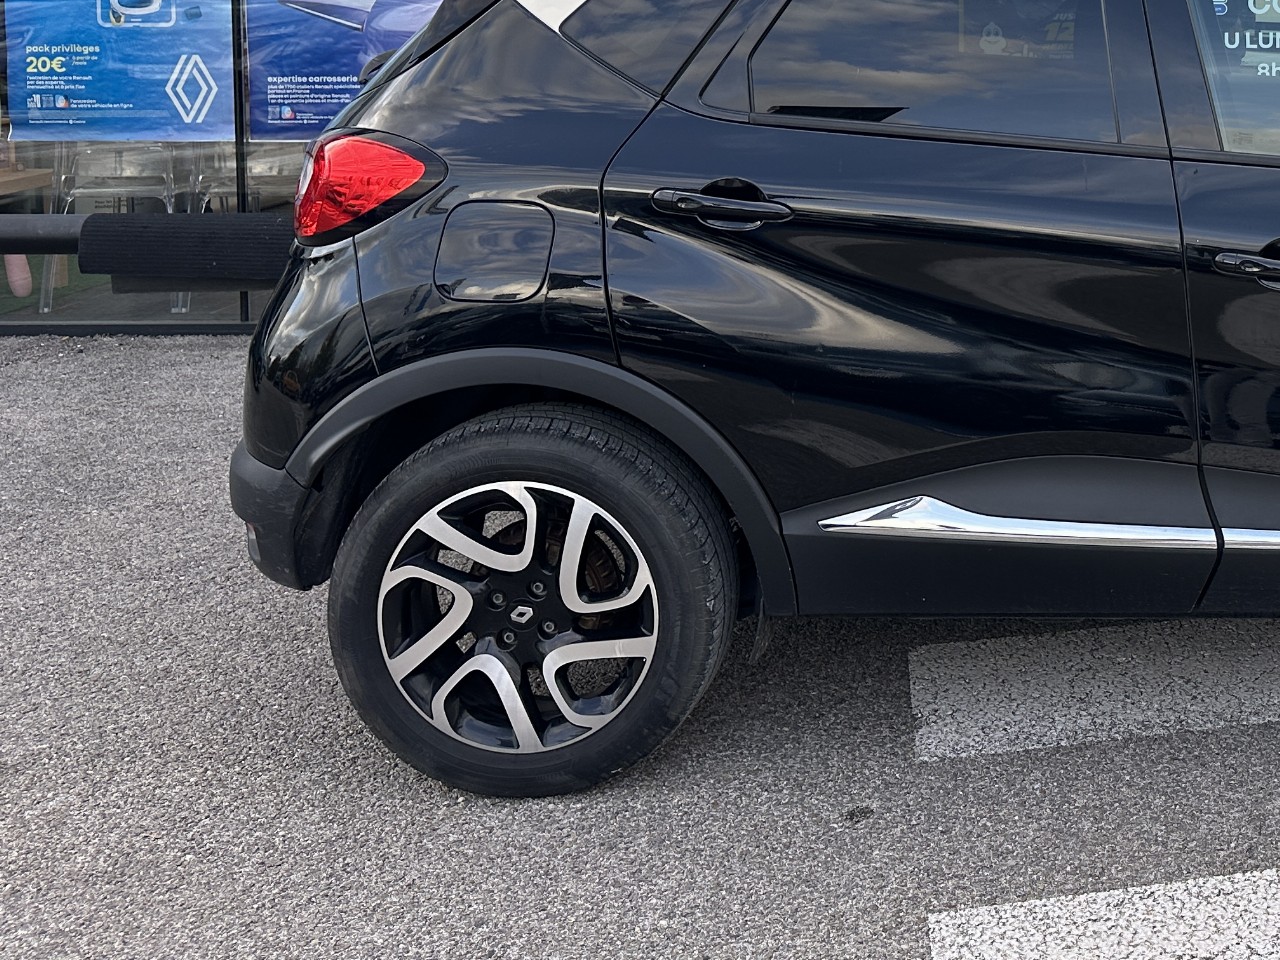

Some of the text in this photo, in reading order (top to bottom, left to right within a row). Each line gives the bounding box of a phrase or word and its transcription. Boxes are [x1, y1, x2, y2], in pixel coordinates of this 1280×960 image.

[1223, 32, 1240, 49] U
[25, 44, 100, 54] pack privilèges
[268, 75, 307, 83] expertise
